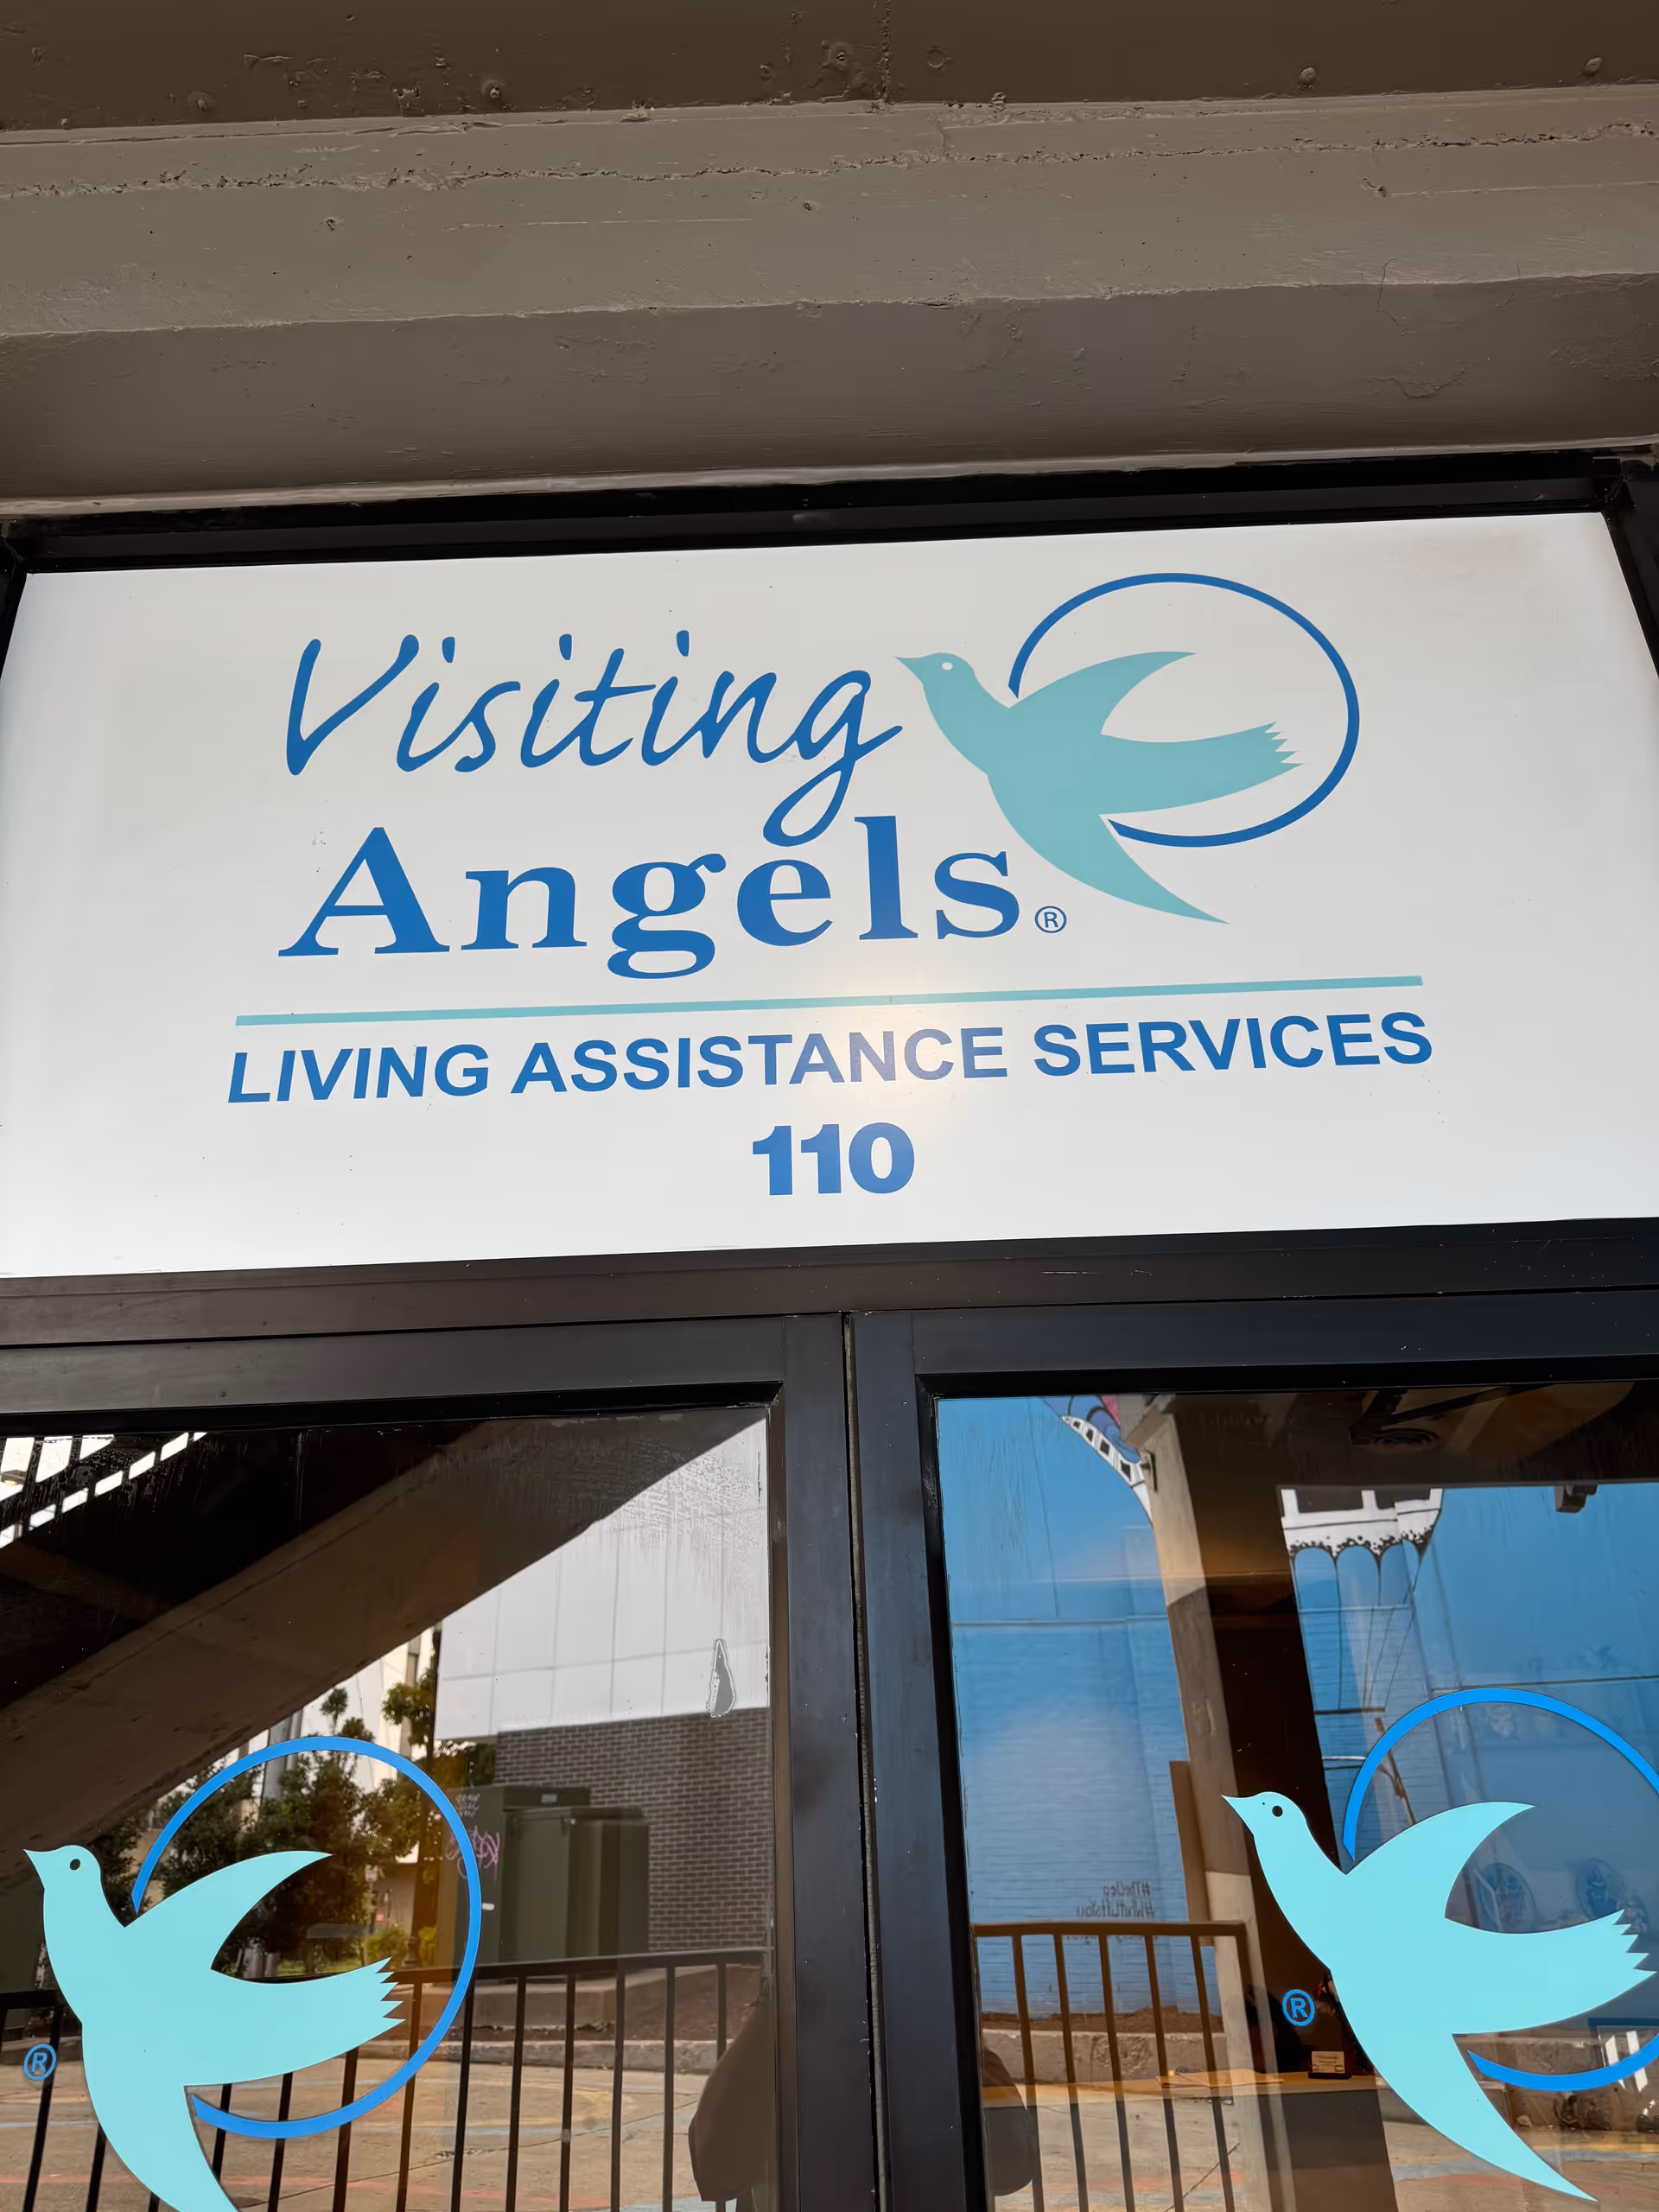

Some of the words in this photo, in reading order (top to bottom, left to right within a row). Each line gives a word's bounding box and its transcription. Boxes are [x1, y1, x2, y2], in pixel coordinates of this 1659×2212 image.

[286, 630, 902, 847] Visiting
[277, 815, 1020, 981] Angels
[228, 1044, 490, 1103] LIVING
[511, 1027, 1007, 1094] ASSISTANCE
[1033, 1012, 1433, 1077] SERVICES
[752, 1122, 915, 1196] 110
